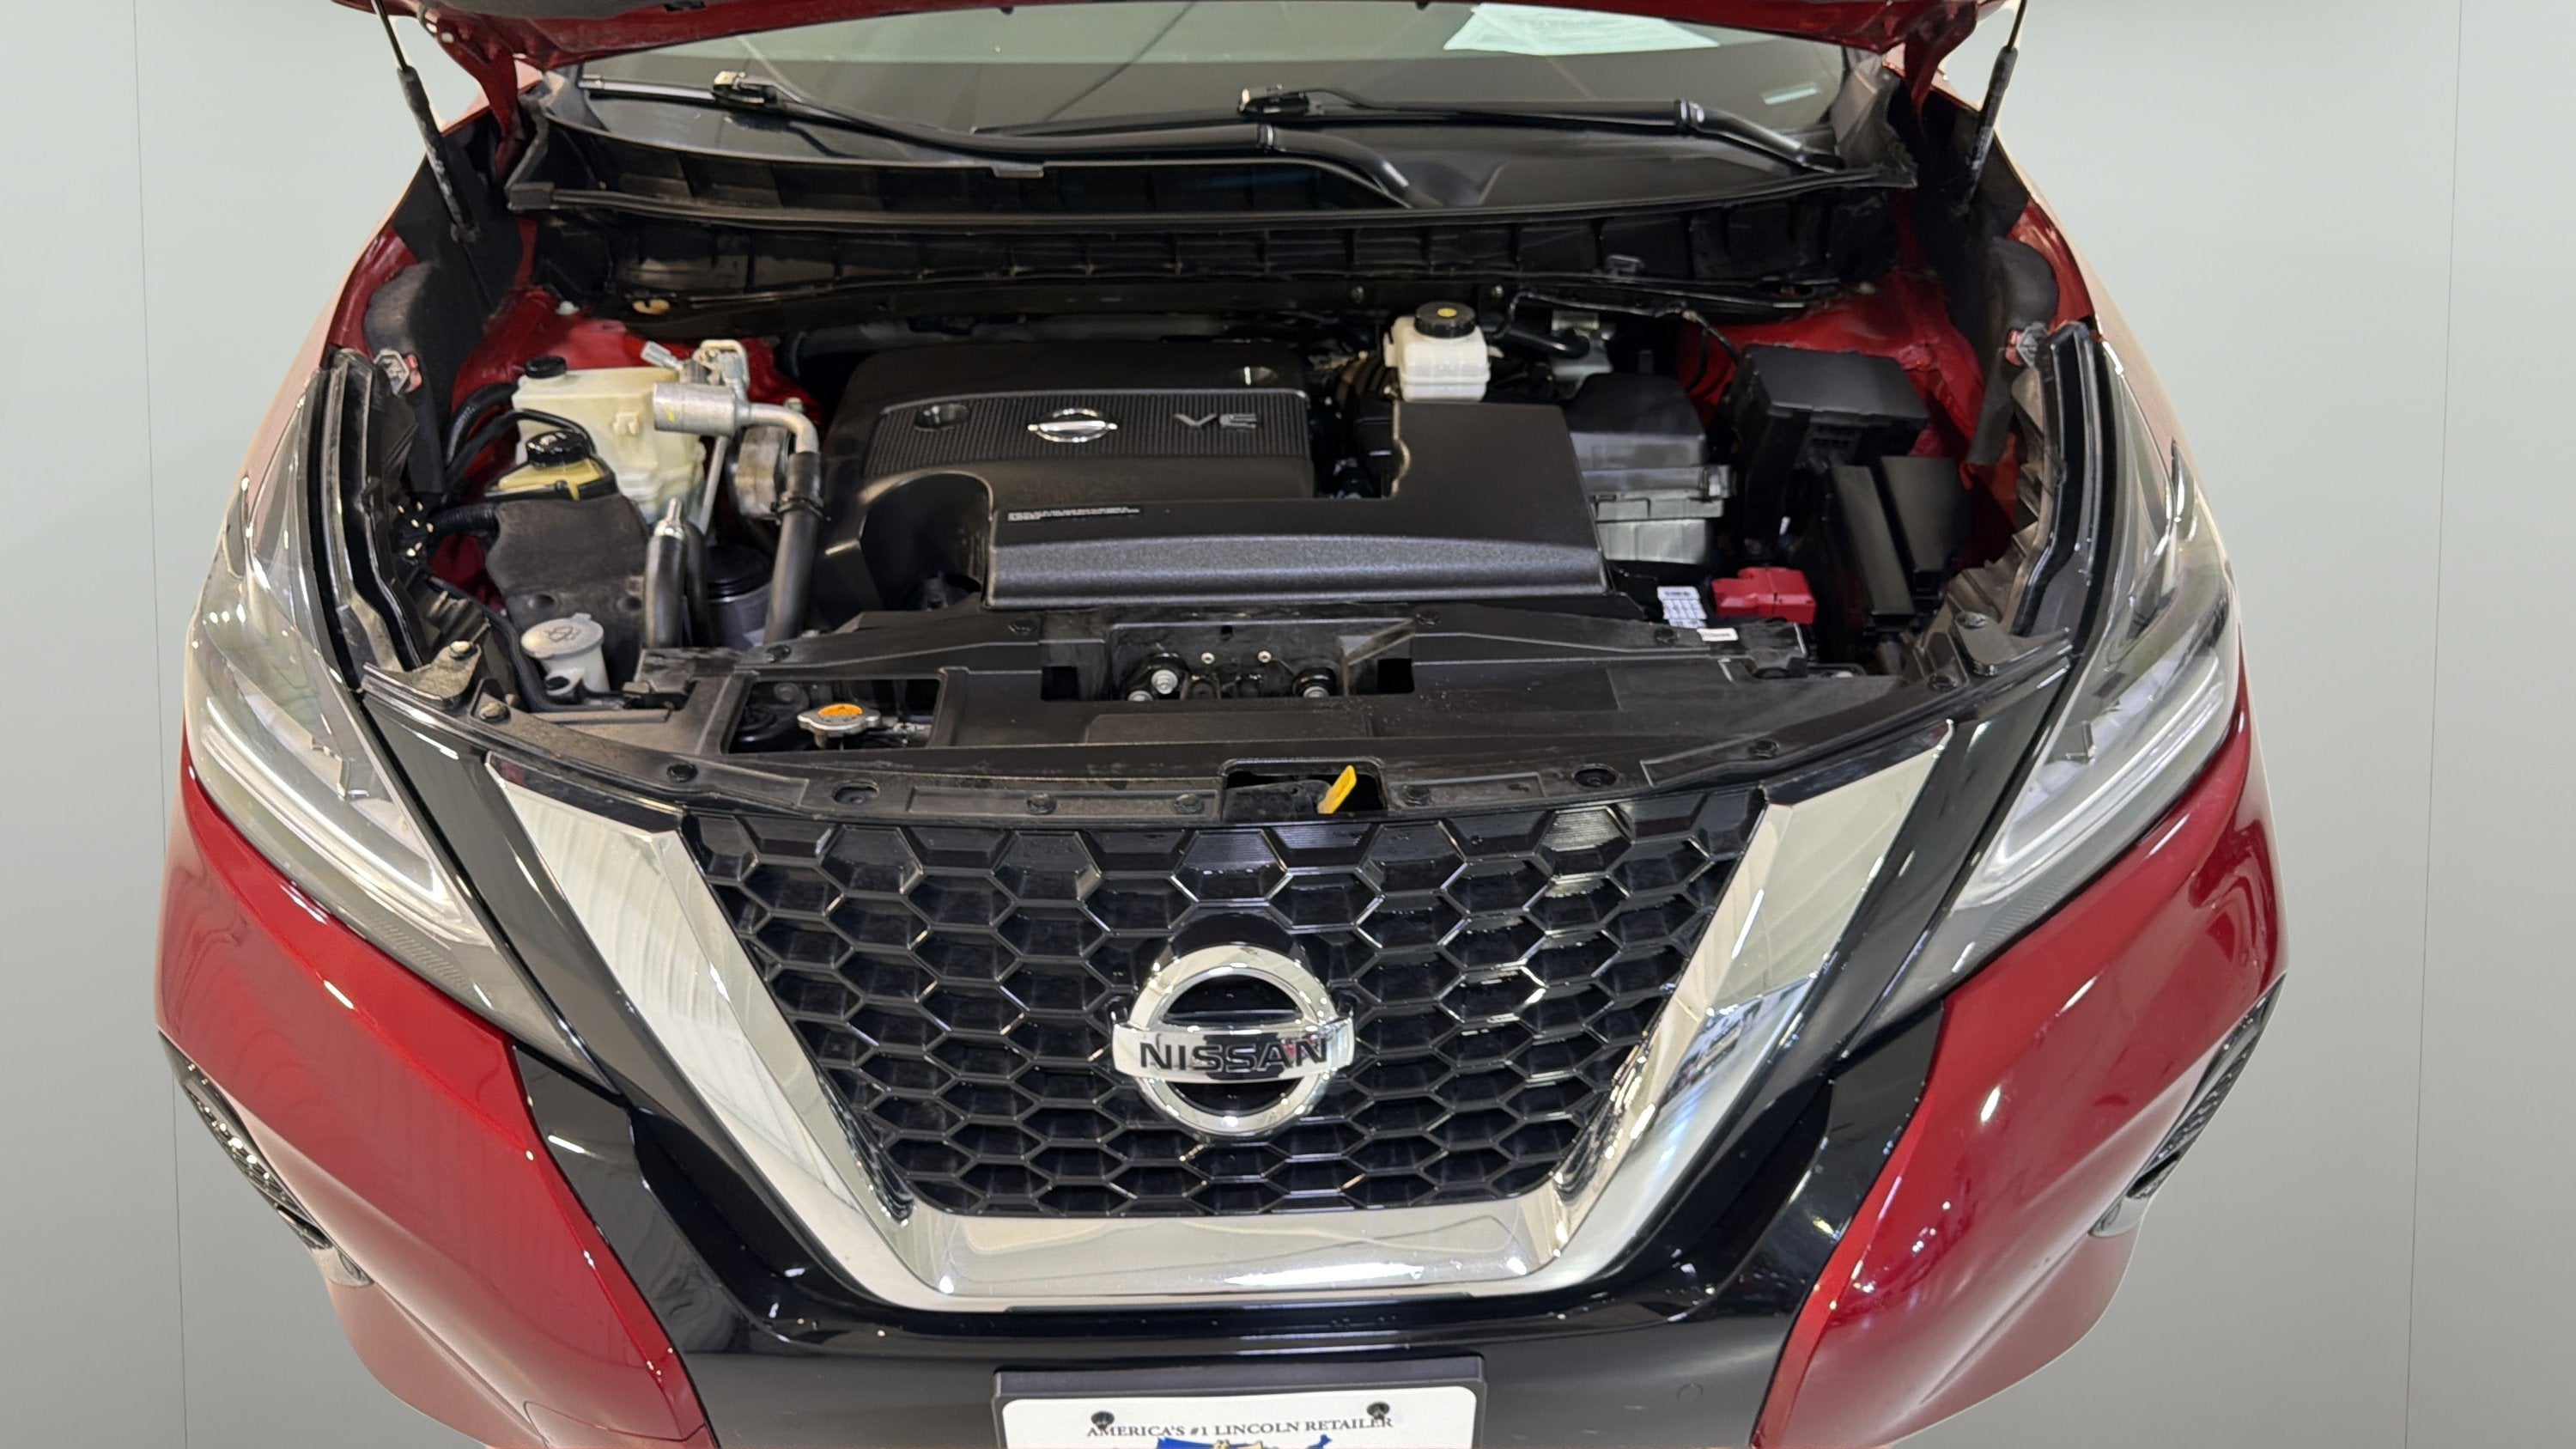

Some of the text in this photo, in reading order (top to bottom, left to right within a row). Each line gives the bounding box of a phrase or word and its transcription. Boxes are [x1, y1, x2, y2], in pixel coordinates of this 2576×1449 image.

[1174, 413, 1257, 429] V6
[1139, 1037, 1328, 1074] NISSAN
[1087, 1417, 1393, 1437] AMERICA'S #1 LINCOLN RETAILER
